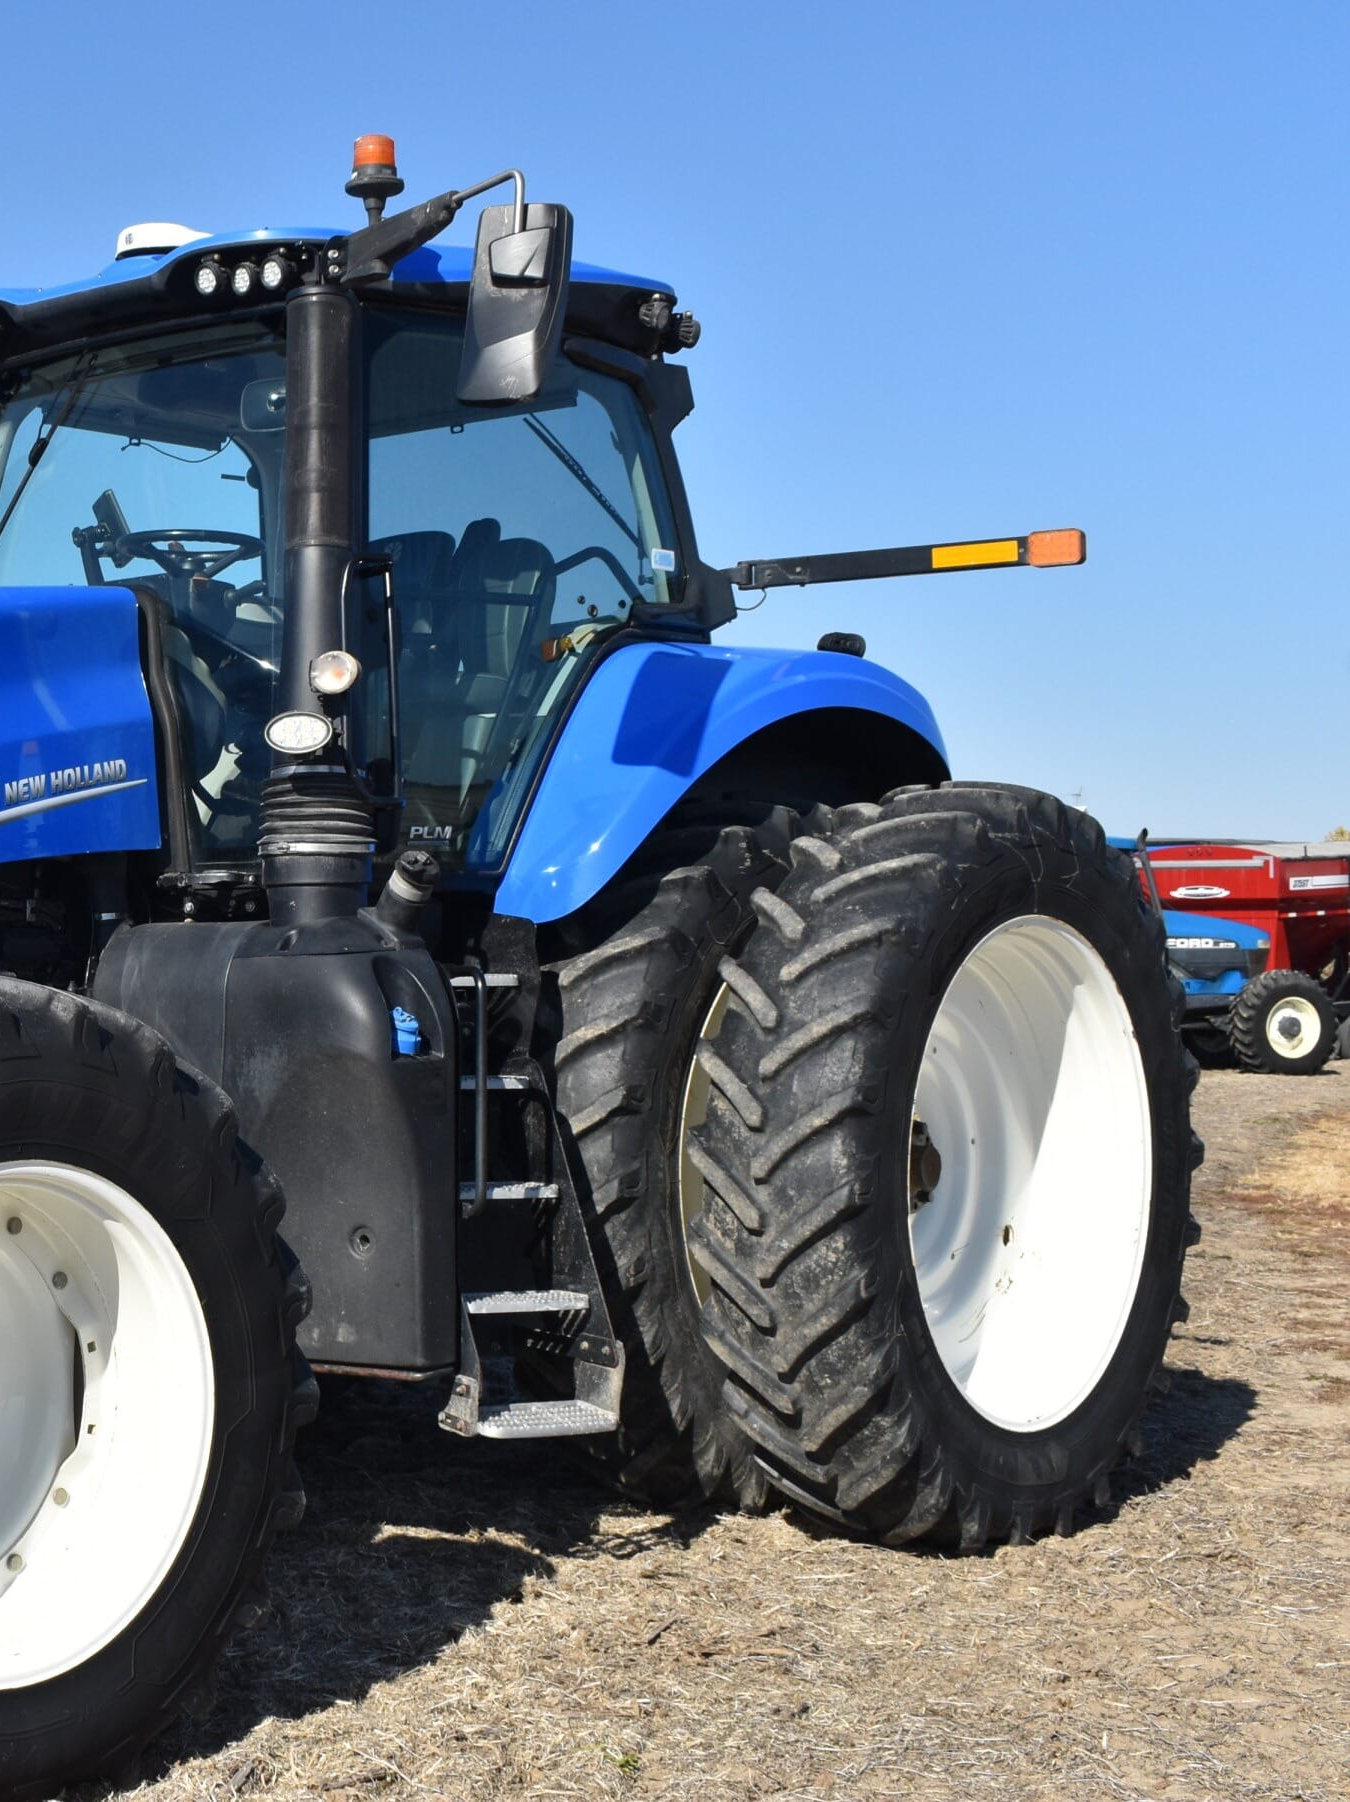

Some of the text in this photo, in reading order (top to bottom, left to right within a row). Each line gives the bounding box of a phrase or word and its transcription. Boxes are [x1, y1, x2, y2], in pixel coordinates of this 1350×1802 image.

[4, 759, 127, 806] NEW HOLLAND
[409, 825, 453, 839] PLM
